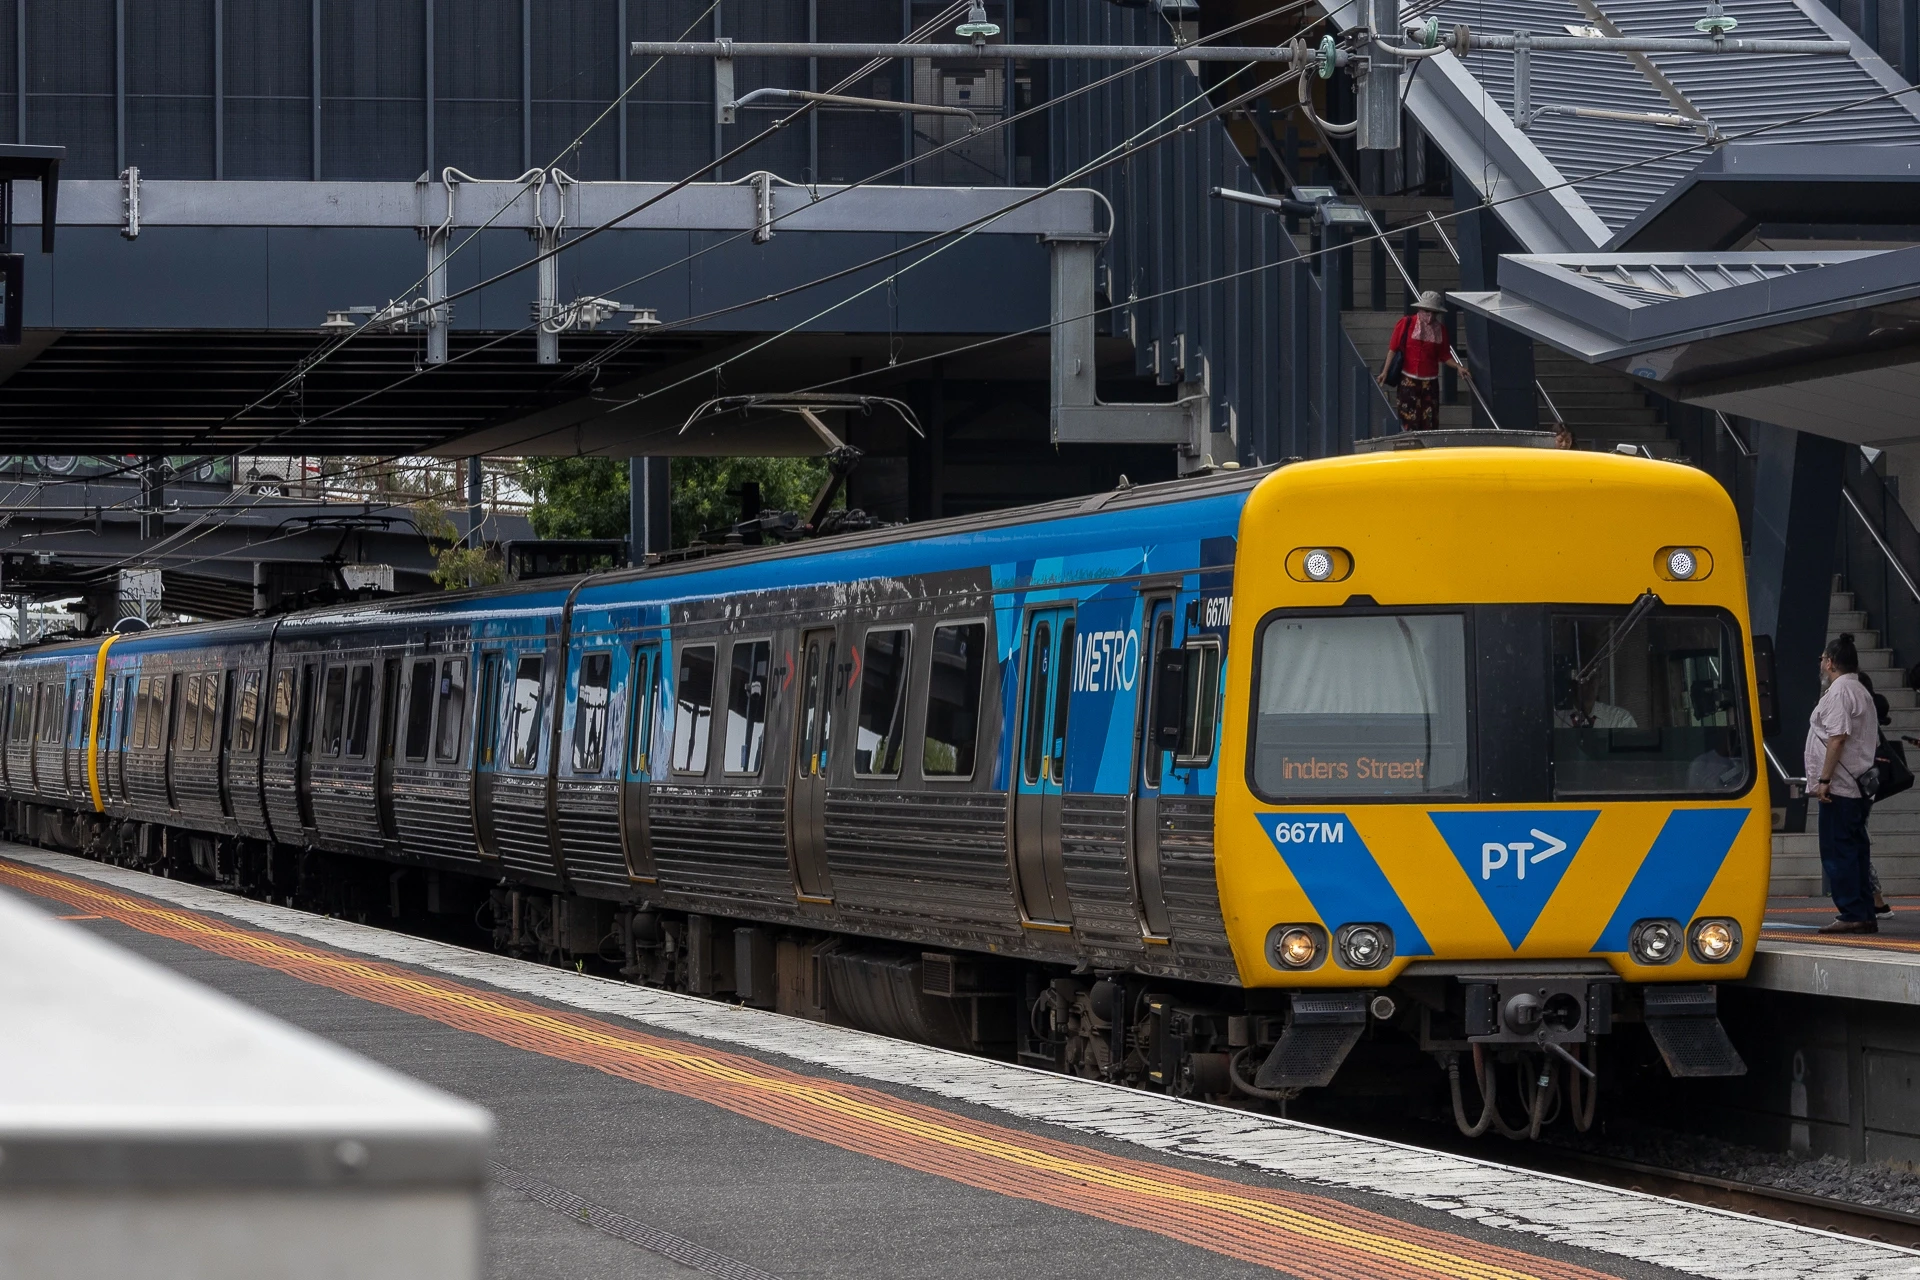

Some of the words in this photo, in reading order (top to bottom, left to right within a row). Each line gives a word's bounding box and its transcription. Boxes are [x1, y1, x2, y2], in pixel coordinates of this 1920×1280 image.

[1206, 596, 1233, 627] 667M
[1073, 628, 1138, 692] METRO
[1356, 757, 1425, 779] Street
[1275, 822, 1344, 844] 667M
